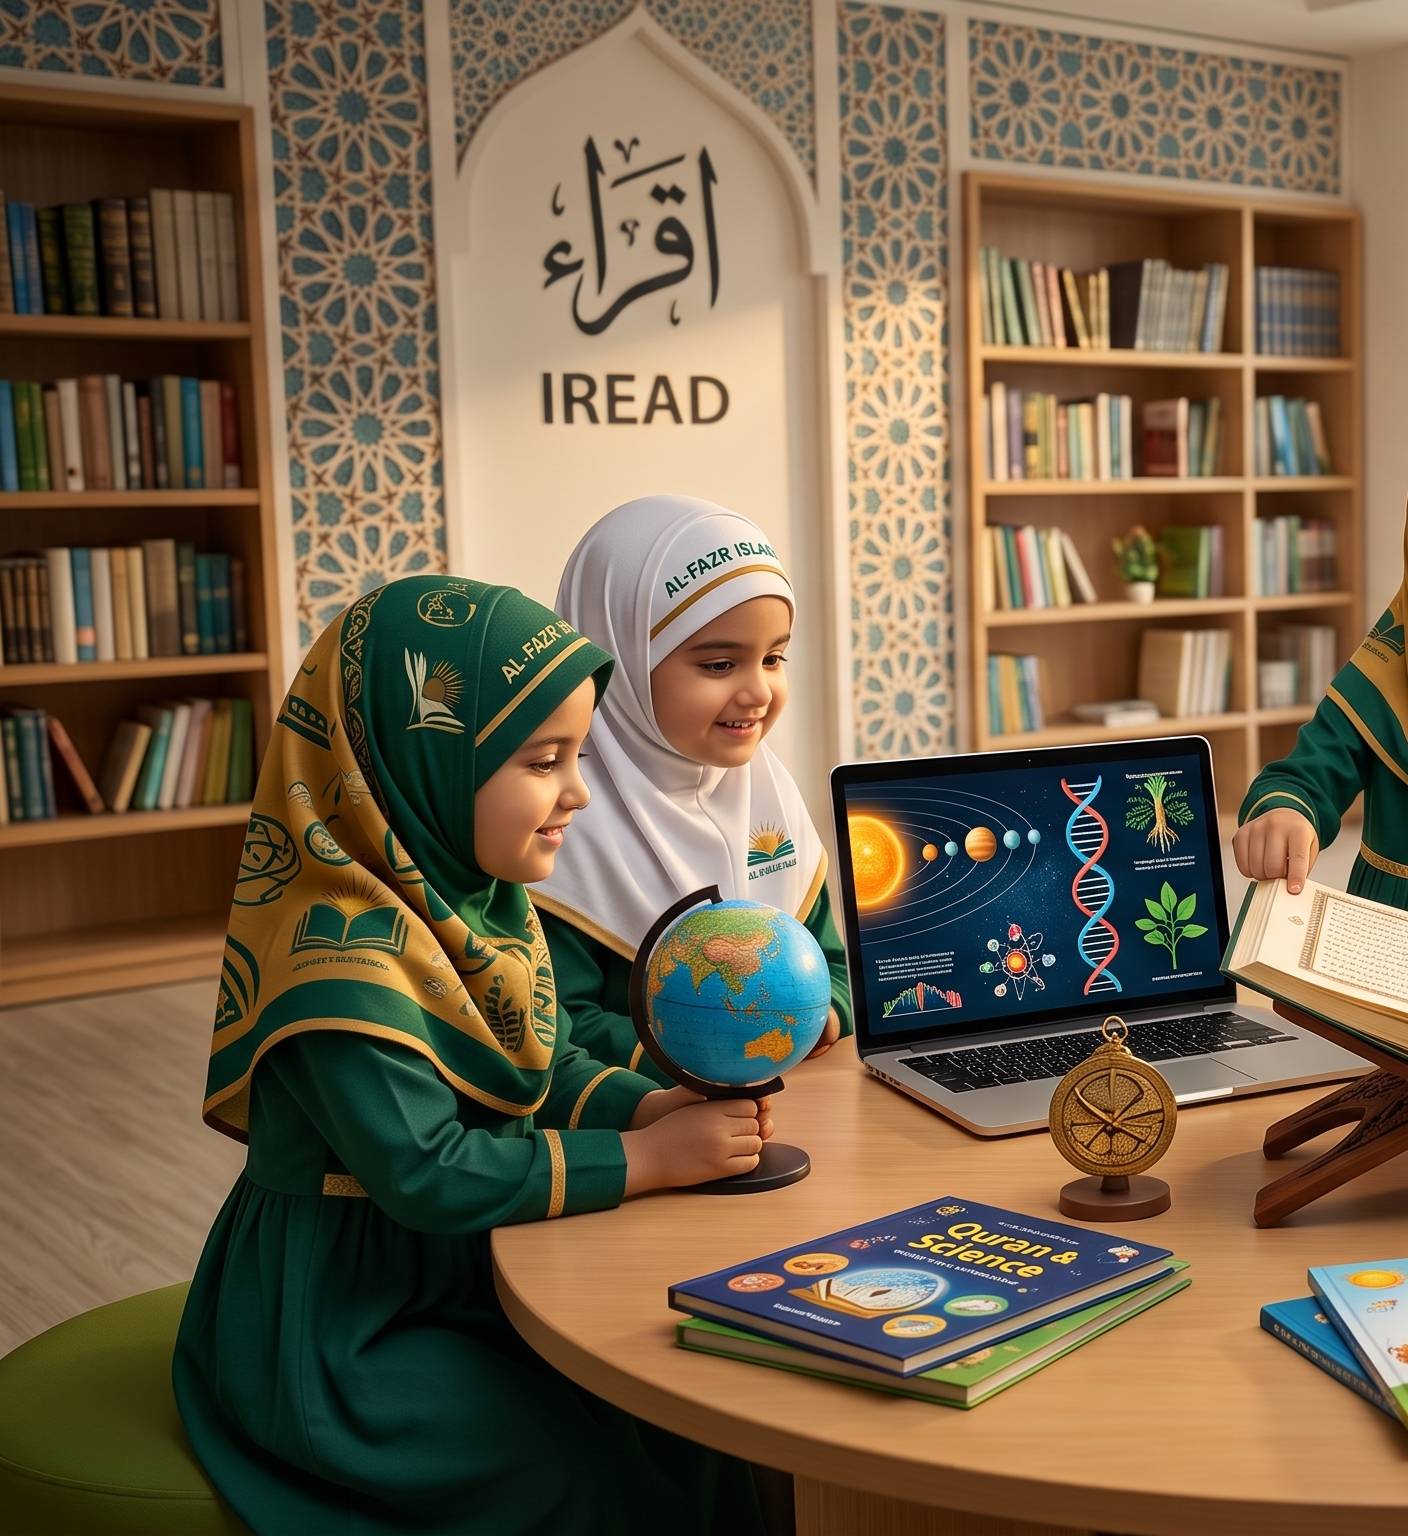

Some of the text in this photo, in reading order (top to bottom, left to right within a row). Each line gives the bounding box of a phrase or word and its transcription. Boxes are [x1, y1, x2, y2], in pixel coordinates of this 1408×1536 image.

[542, 372, 730, 425] IREAD
[664, 546, 733, 599] AL-FAZR
[501, 624, 562, 685] AL-FAZR
[907, 1233, 1044, 1279] Science
[947, 1222, 1052, 1259] Quran
[1049, 1250, 1079, 1266] &
